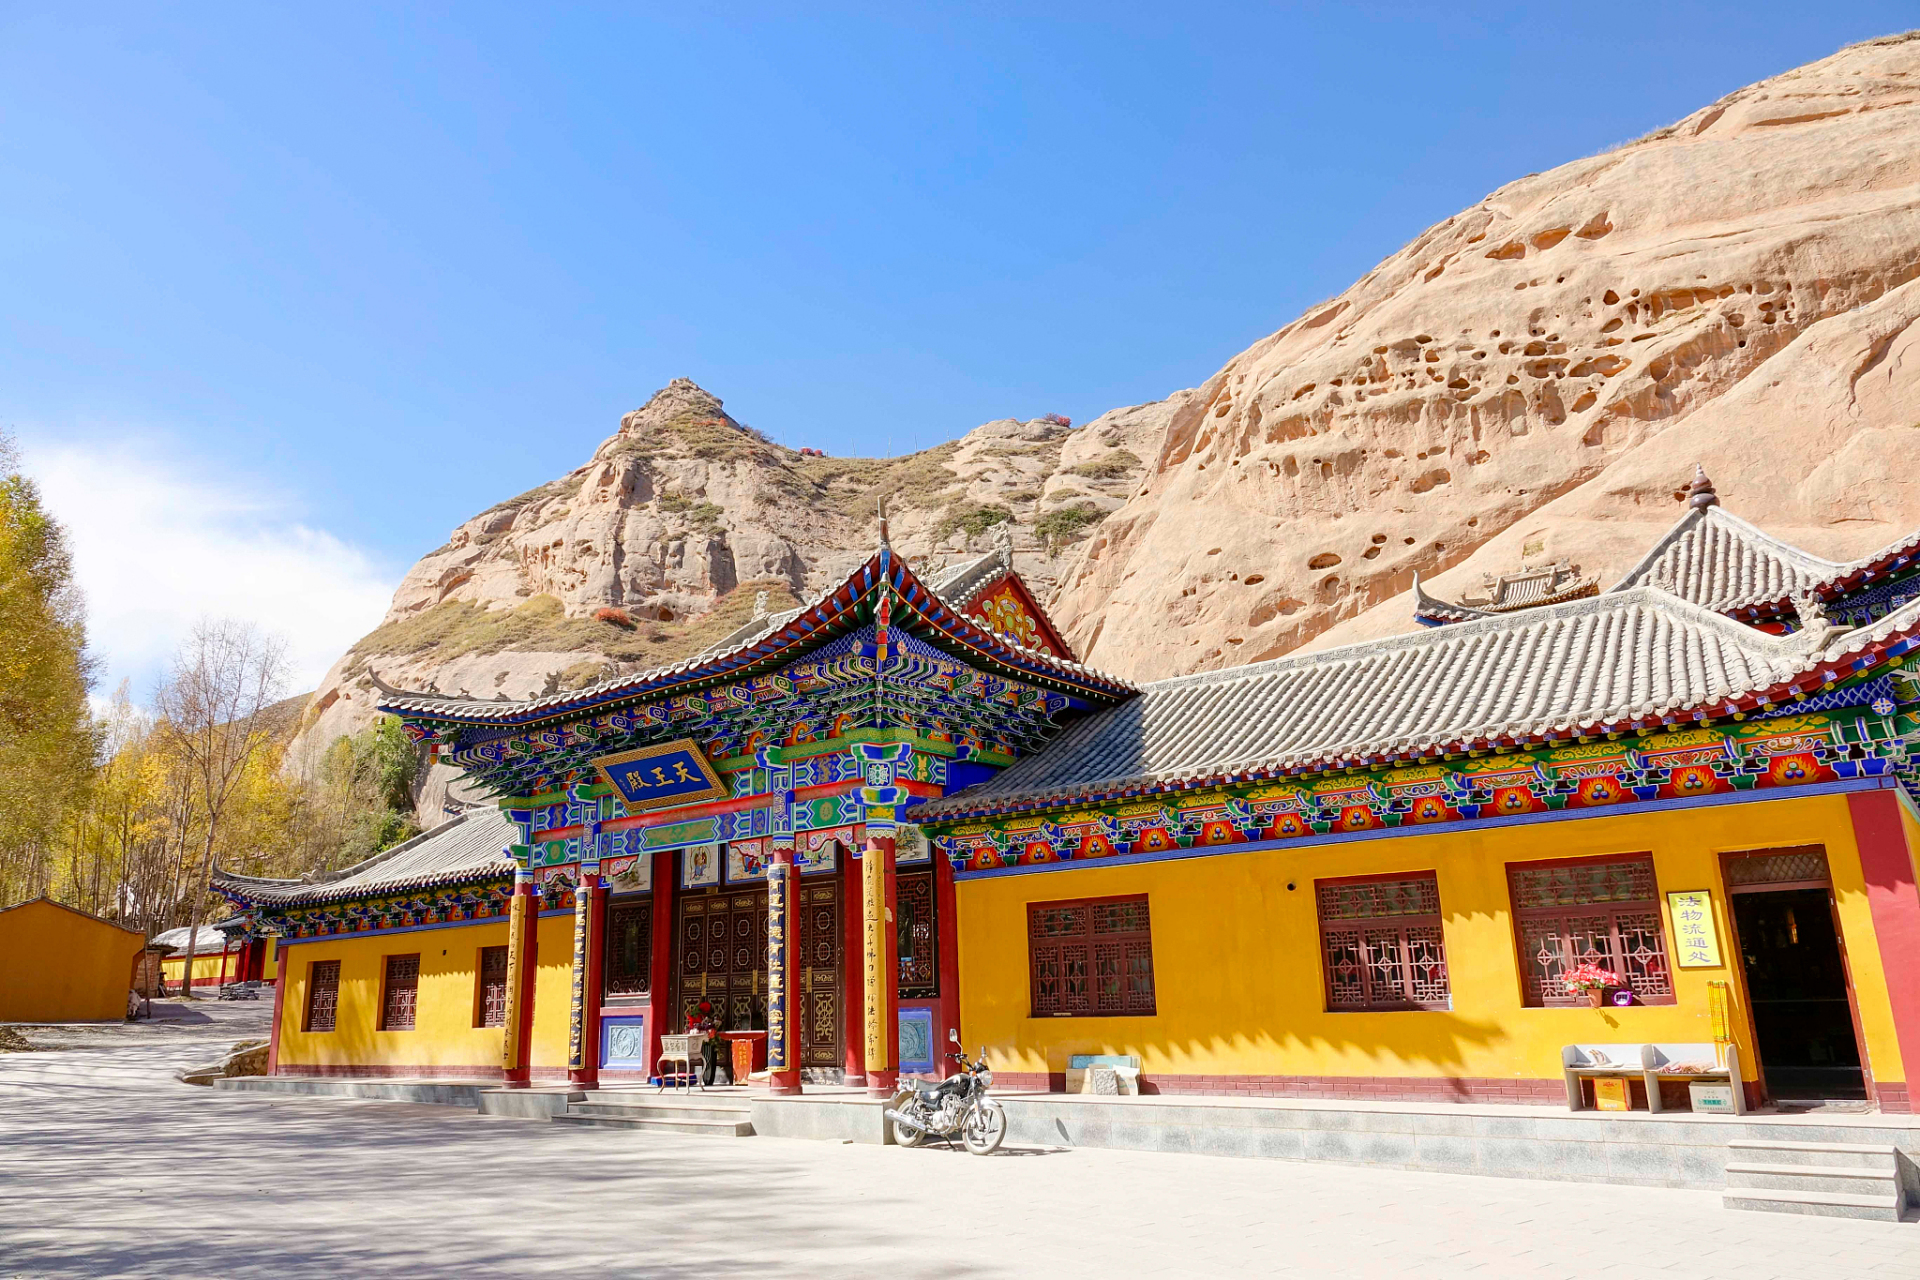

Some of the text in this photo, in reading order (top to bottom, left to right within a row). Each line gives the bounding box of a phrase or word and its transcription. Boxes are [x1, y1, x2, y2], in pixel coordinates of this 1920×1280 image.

[626, 761, 702, 793] 天王殿
[1678, 896, 1711, 963] 法物流通处
